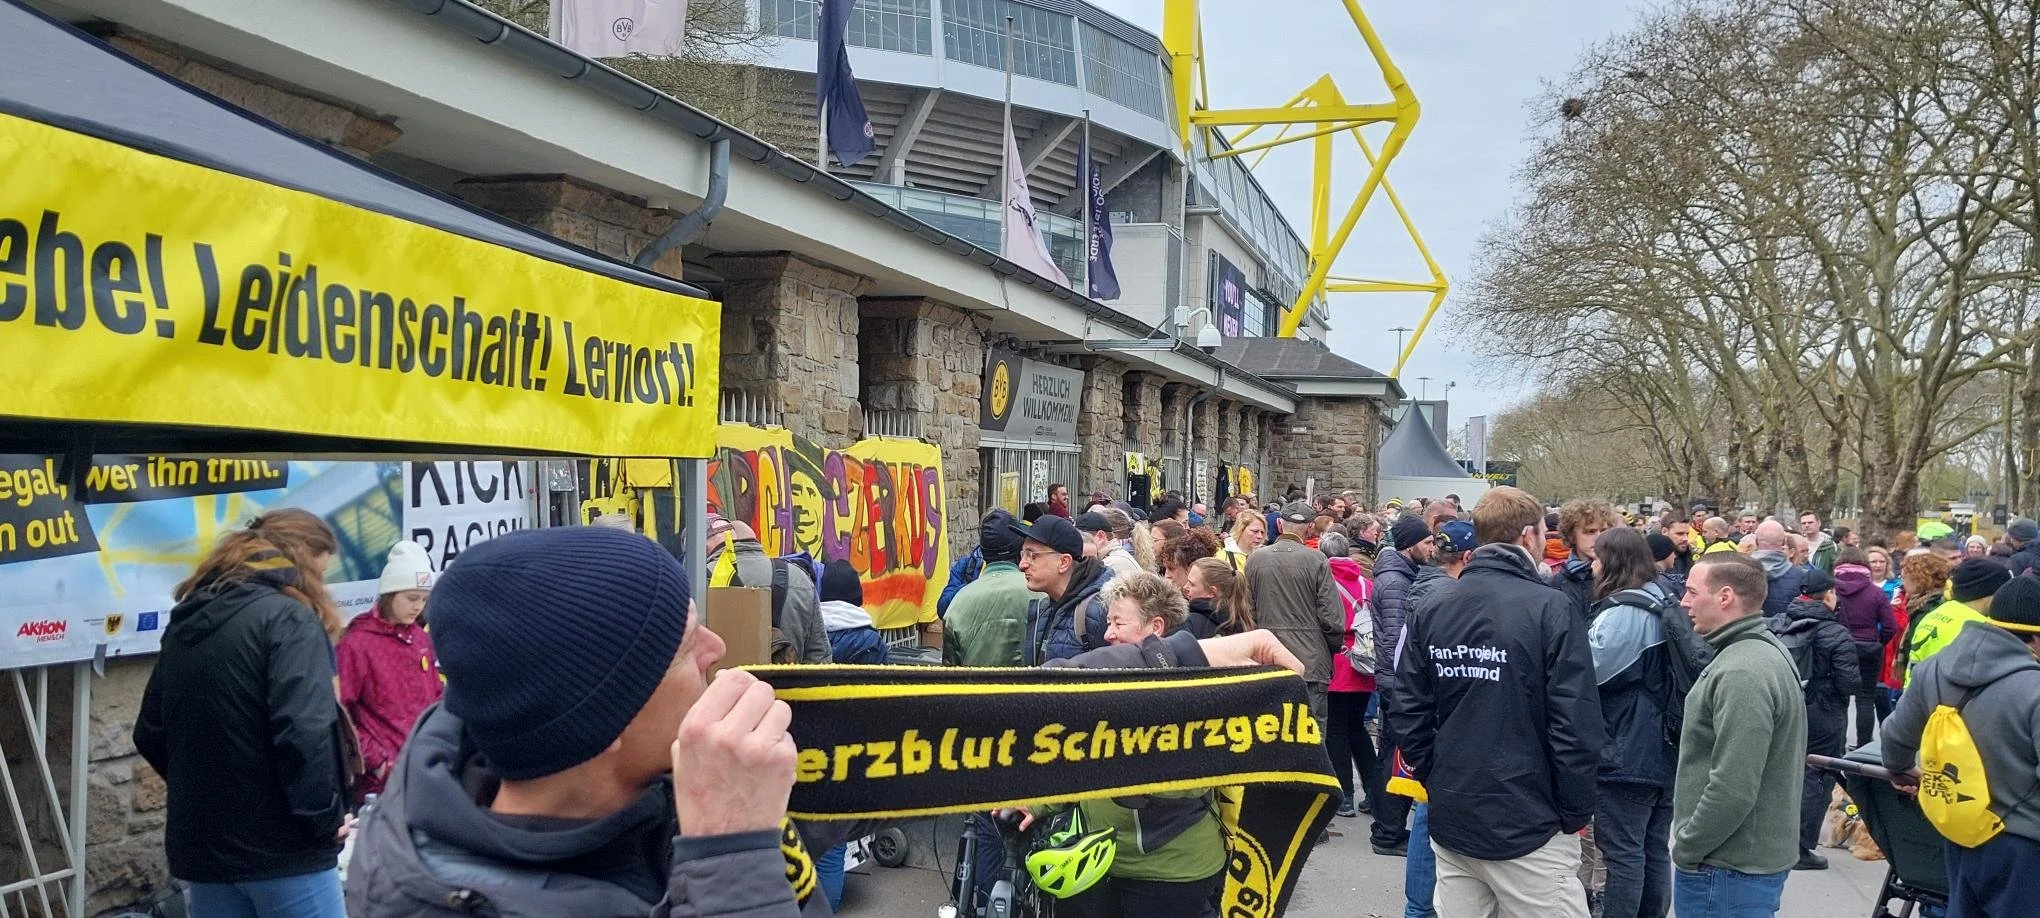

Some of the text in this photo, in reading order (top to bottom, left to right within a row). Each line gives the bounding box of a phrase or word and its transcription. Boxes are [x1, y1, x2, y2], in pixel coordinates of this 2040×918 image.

[616, 22, 632, 33] BVB
[193, 243, 552, 392] Leidenschaft!
[563, 321, 696, 408] Lernort!
[1032, 373, 1071, 400] HERZLICH
[1023, 397, 1075, 424] WILLKOMMEN!
[148, 456, 198, 487] ihn
[411, 461, 524, 508] KICK
[26, 510, 79, 548] out
[823, 450, 942, 579] CZERKUS
[37, 633, 65, 643] MENSCH
[1429, 645, 1507, 663] Fan-Projekt
[1027, 702, 1321, 764] Schwarzgelb
